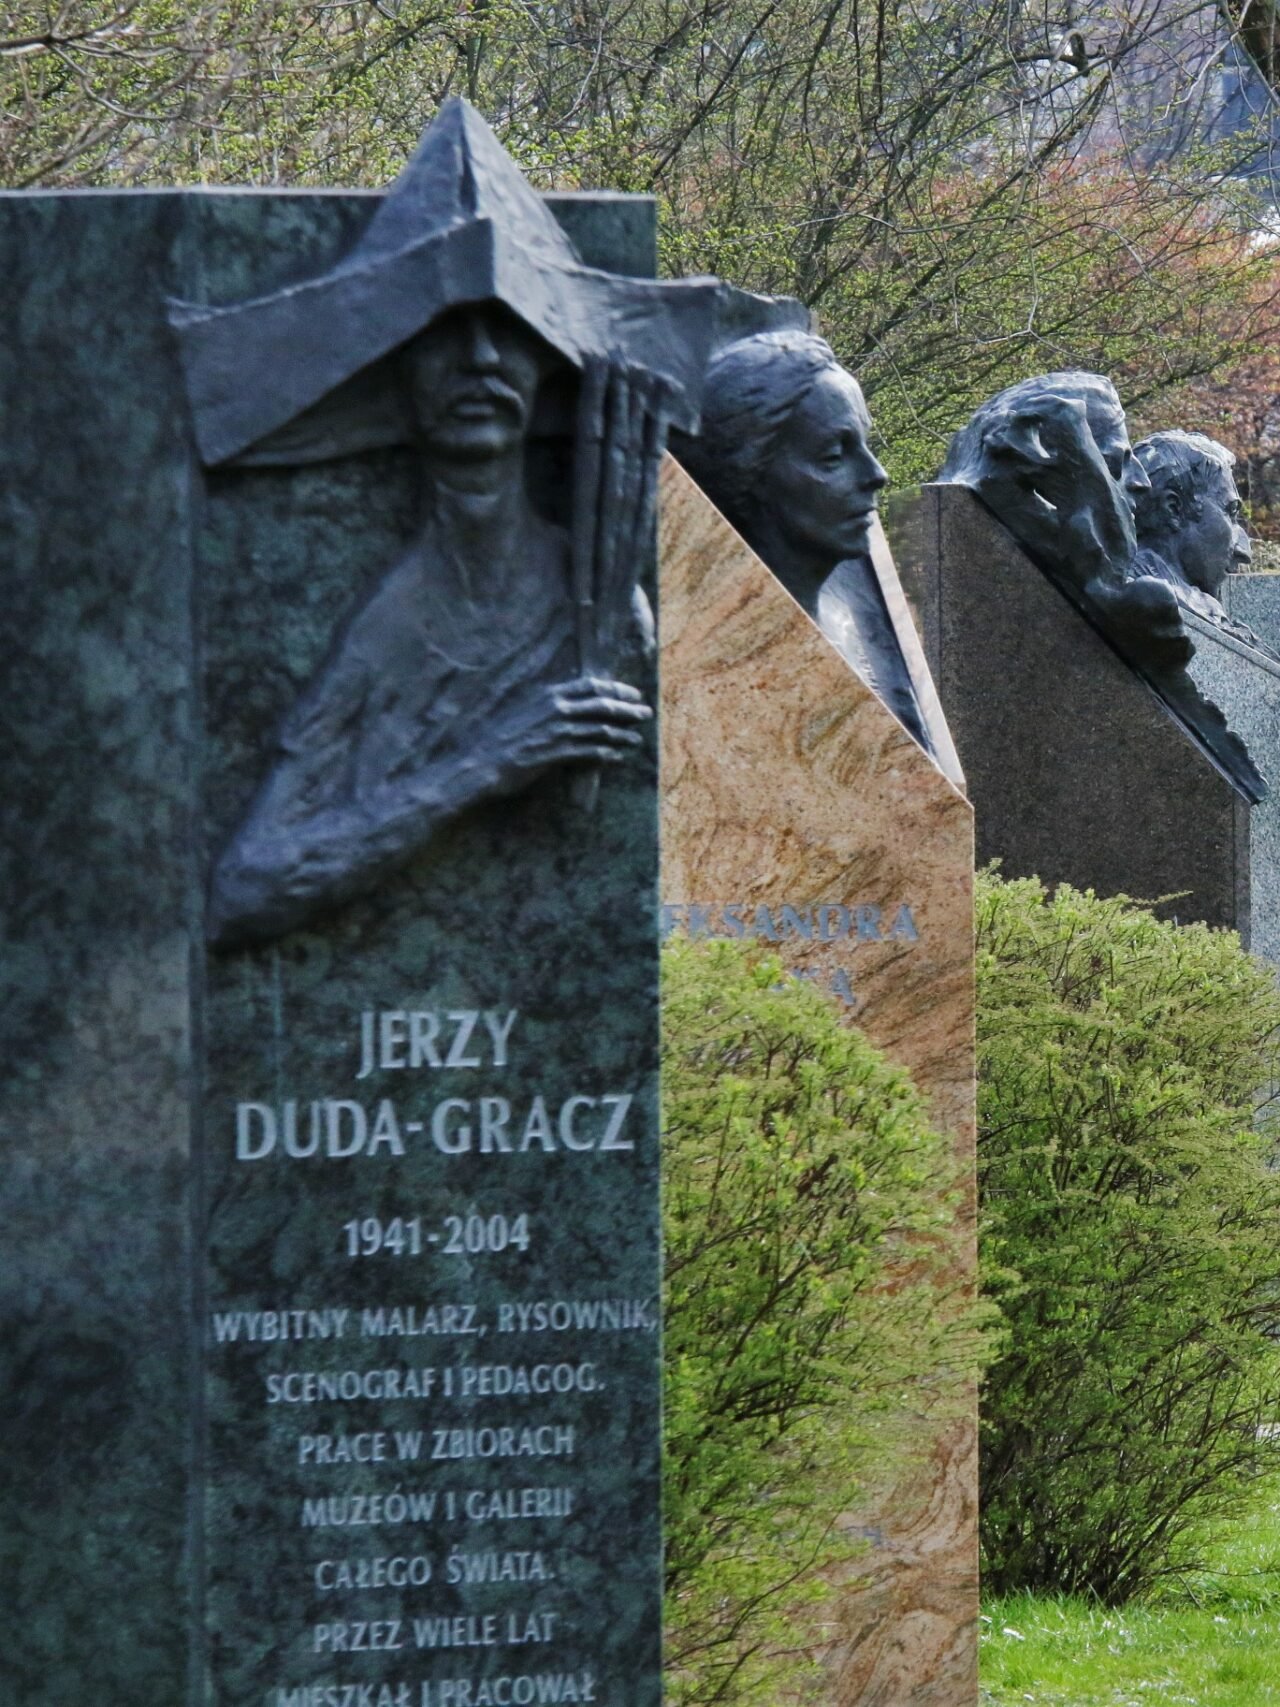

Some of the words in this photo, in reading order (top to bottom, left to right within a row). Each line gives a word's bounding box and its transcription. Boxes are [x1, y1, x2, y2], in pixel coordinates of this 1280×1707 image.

[357, 1008, 518, 1079] JERZY
[236, 1094, 634, 1160] DUDA-GRACZ
[344, 1212, 530, 1257] 1941-2004
[212, 1309, 348, 1343] WYBITNY
[360, 1303, 487, 1338] MALARZ,
[499, 1299, 657, 1333] RYSOWNIK,
[266, 1367, 436, 1403] SCENOGRAF
[443, 1367, 452, 1397] I
[461, 1363, 605, 1396] PEDAGOG.
[299, 1431, 385, 1465] PRACE
[394, 1430, 421, 1461] W
[431, 1425, 576, 1460] ZBIORACH
[302, 1484, 437, 1527] MUZEÓW
[446, 1492, 455, 1521] I
[465, 1487, 573, 1520] GALERII
[314, 1556, 430, 1591] CAŁEGO
[446, 1545, 555, 1585] ŚWIATA.
[313, 1620, 401, 1652] PRZEZ
[414, 1614, 497, 1648] WIELE
[508, 1612, 560, 1644] LAT
[421, 1680, 430, 1707] I
[433, 1671, 597, 1707] PRACOWAŁ
